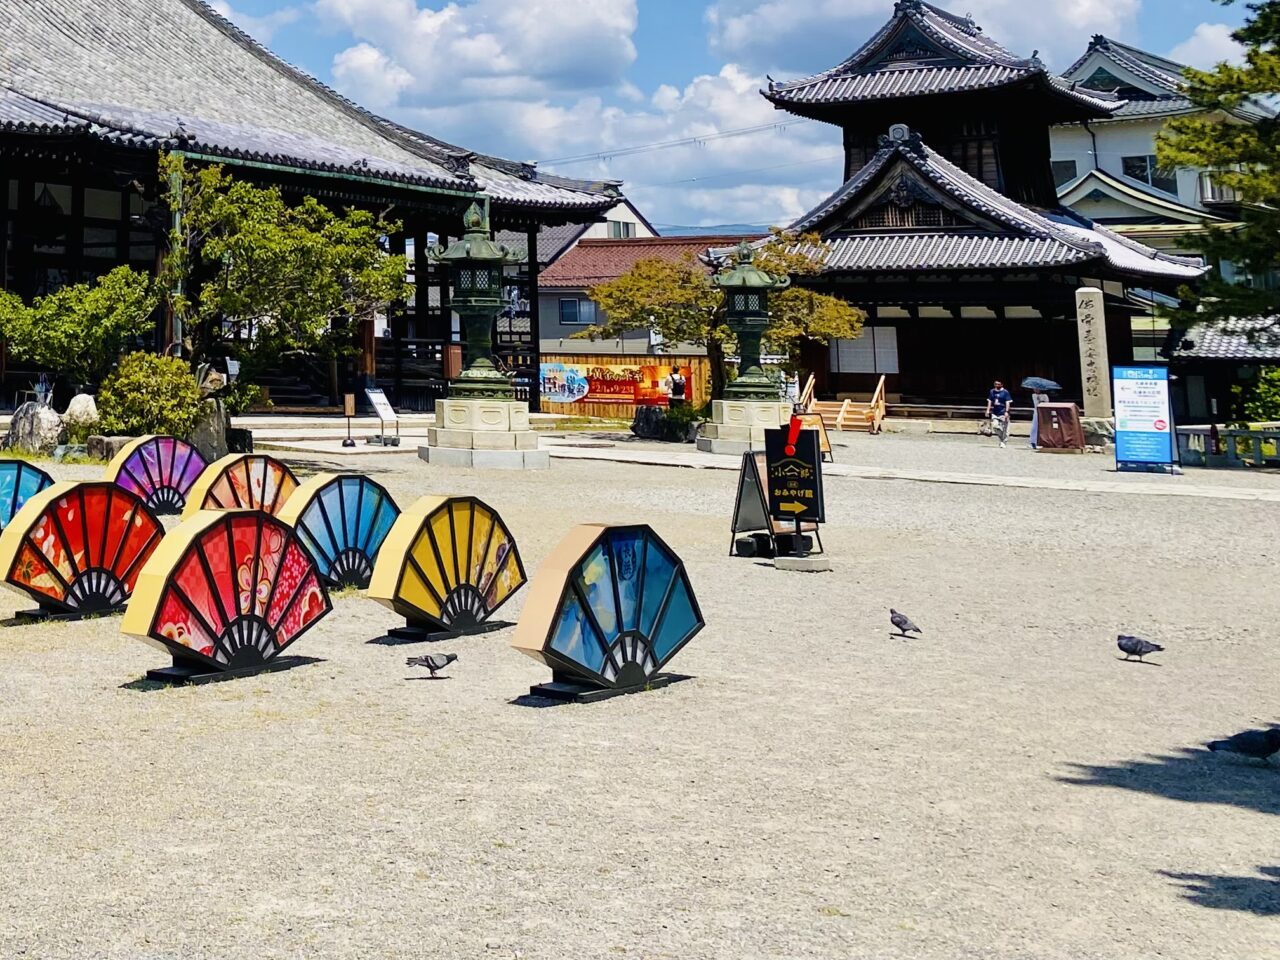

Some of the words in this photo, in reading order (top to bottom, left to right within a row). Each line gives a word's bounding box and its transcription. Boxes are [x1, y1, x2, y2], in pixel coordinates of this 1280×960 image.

[774, 488, 814, 499] おみやげ館
